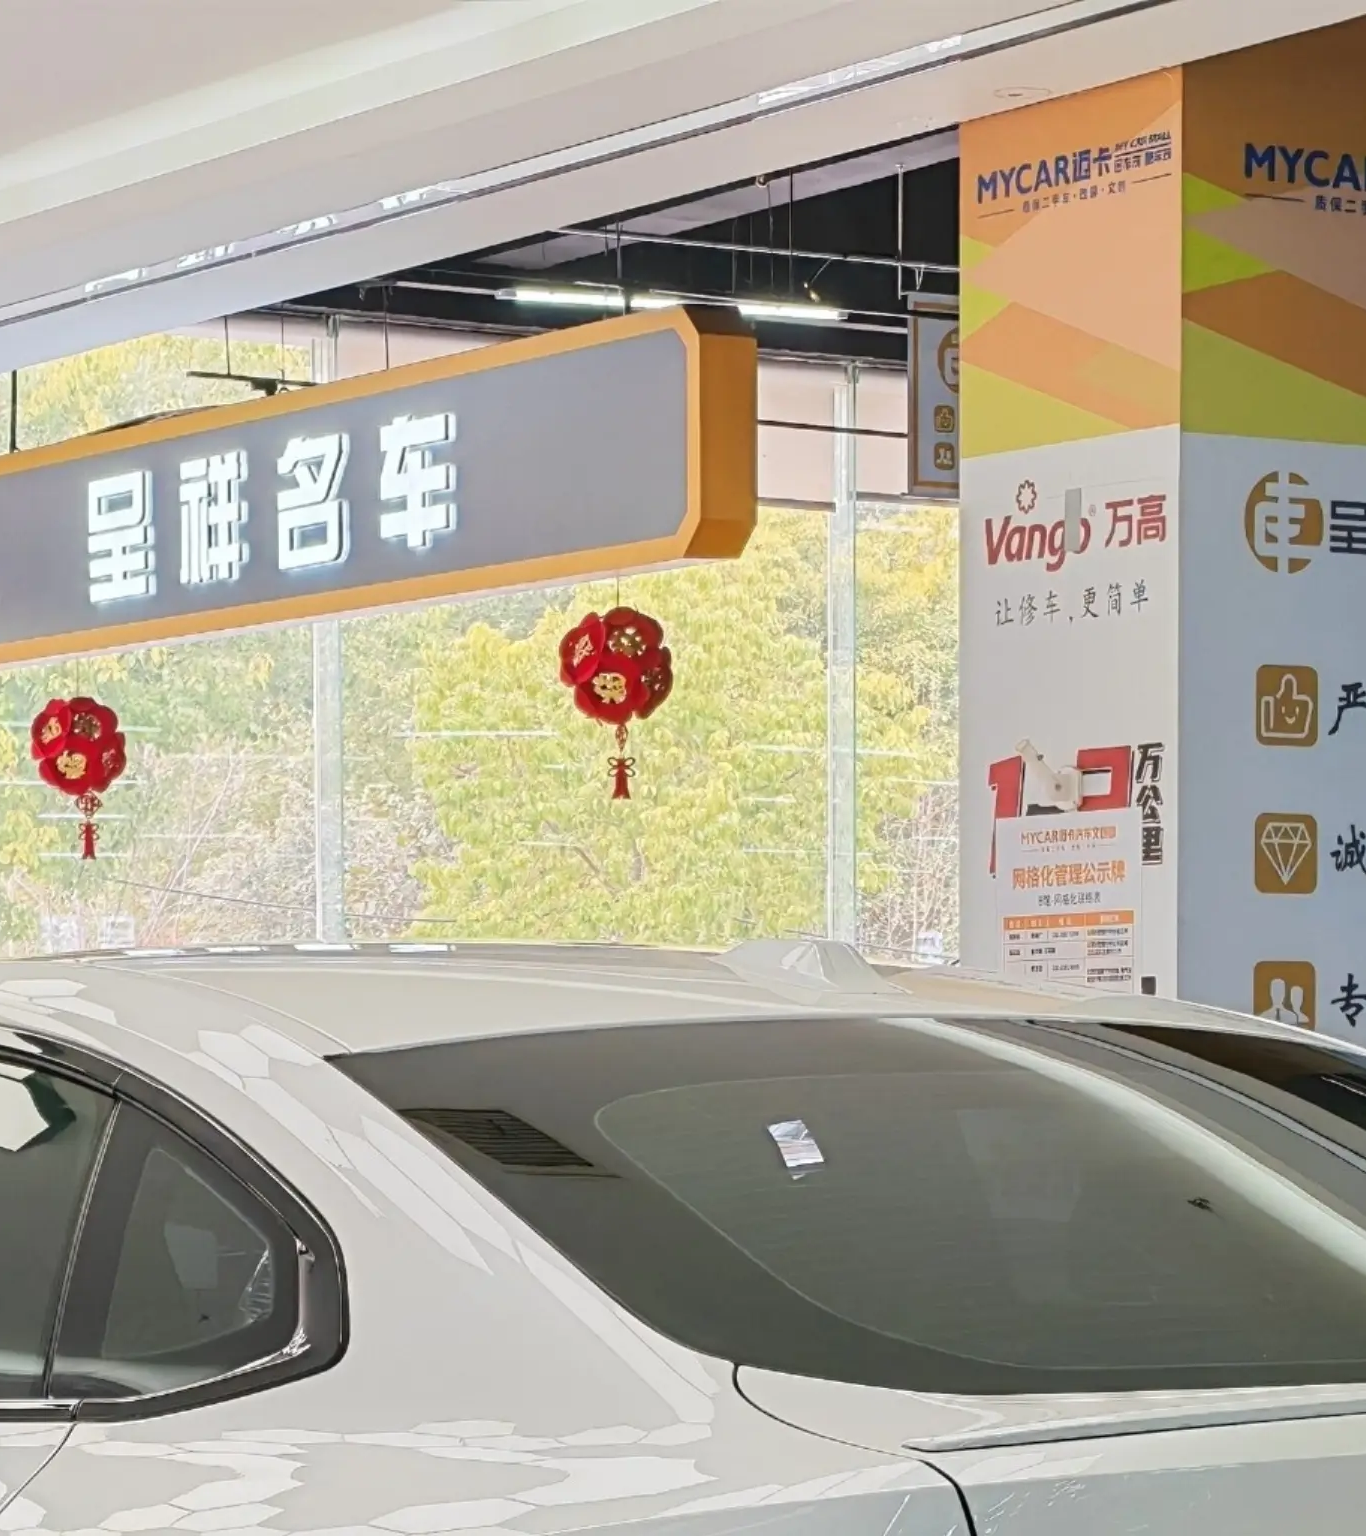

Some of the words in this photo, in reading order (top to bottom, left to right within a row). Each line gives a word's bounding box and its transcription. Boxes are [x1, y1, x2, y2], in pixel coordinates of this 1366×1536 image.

[977, 147, 1112, 204] MYCAR迈卡
[87, 411, 458, 604] 呈祥名车
[1104, 493, 1167, 549] 万高
[1135, 741, 1165, 867] 万公里
